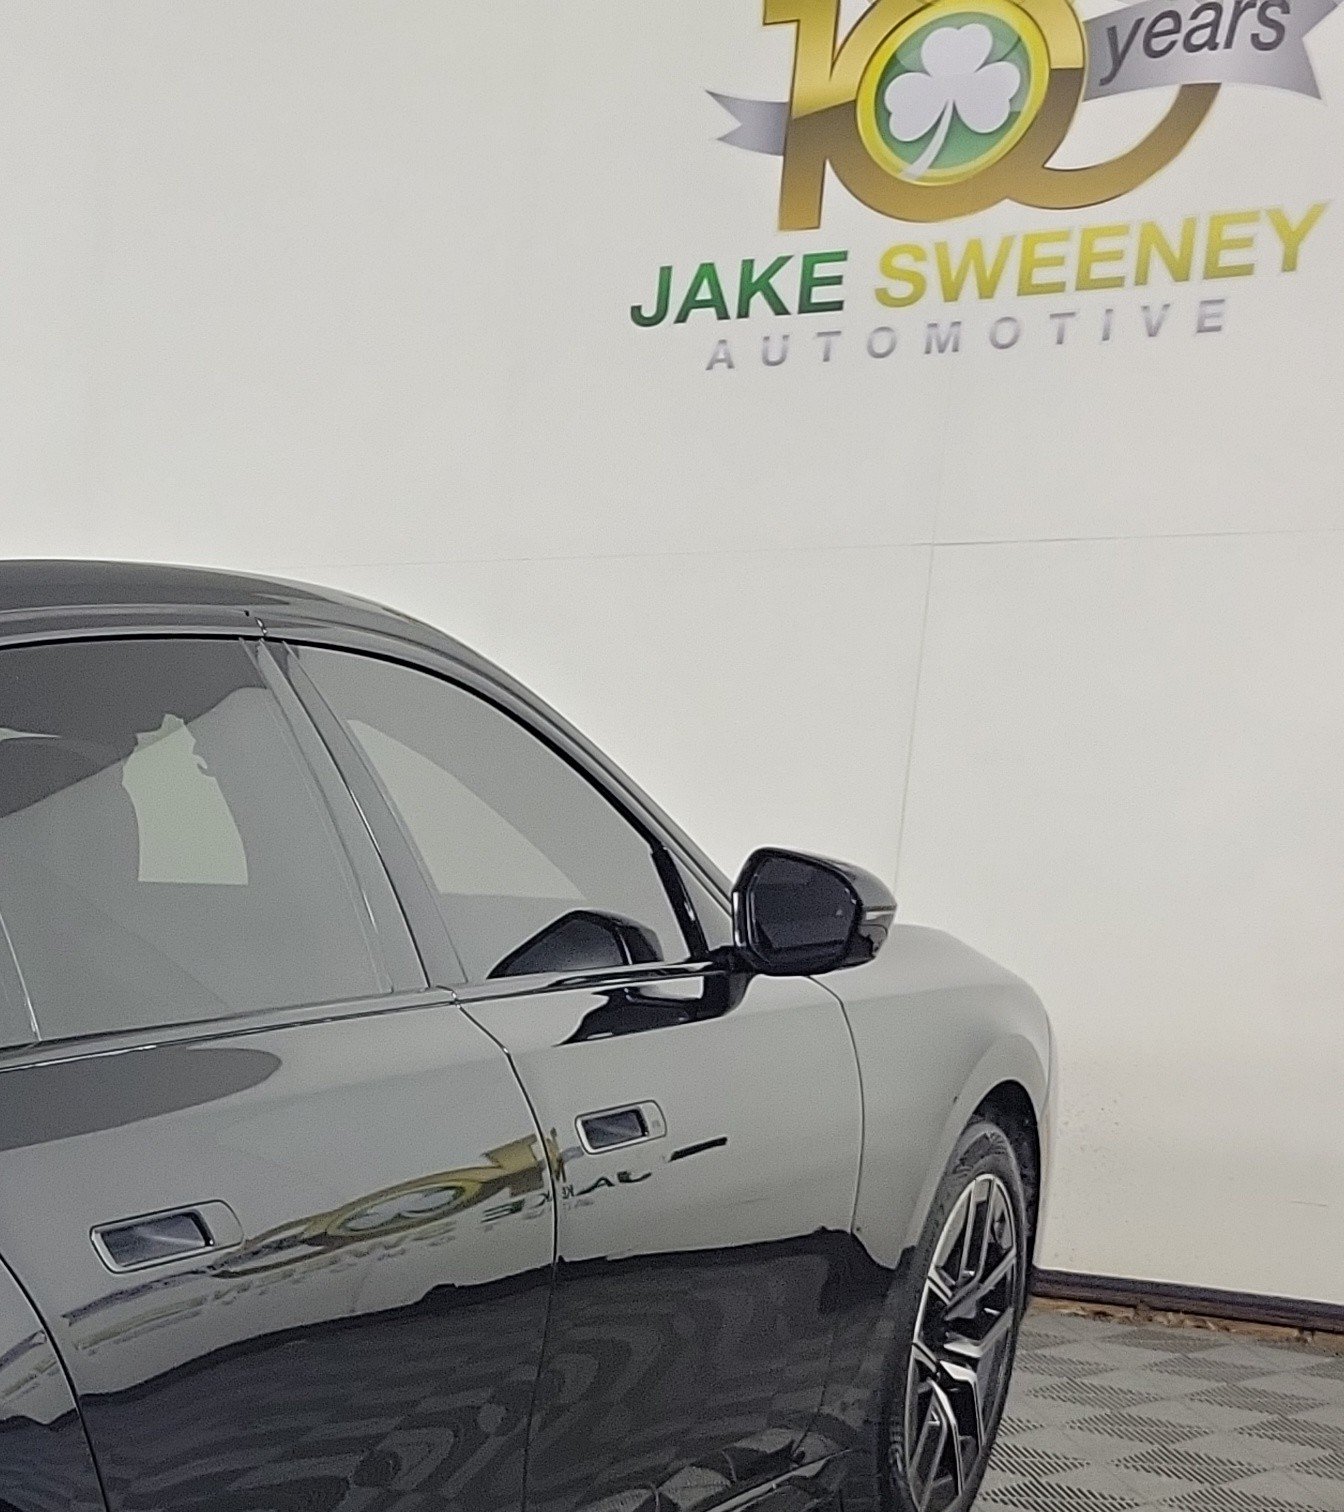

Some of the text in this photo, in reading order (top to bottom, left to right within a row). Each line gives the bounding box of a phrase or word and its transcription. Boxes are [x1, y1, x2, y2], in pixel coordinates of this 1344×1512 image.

[1099, 0, 1292, 84] years
[629, 203, 1328, 328] JAKE SWEENEY
[704, 299, 1228, 371] AUTOMOTIVE
